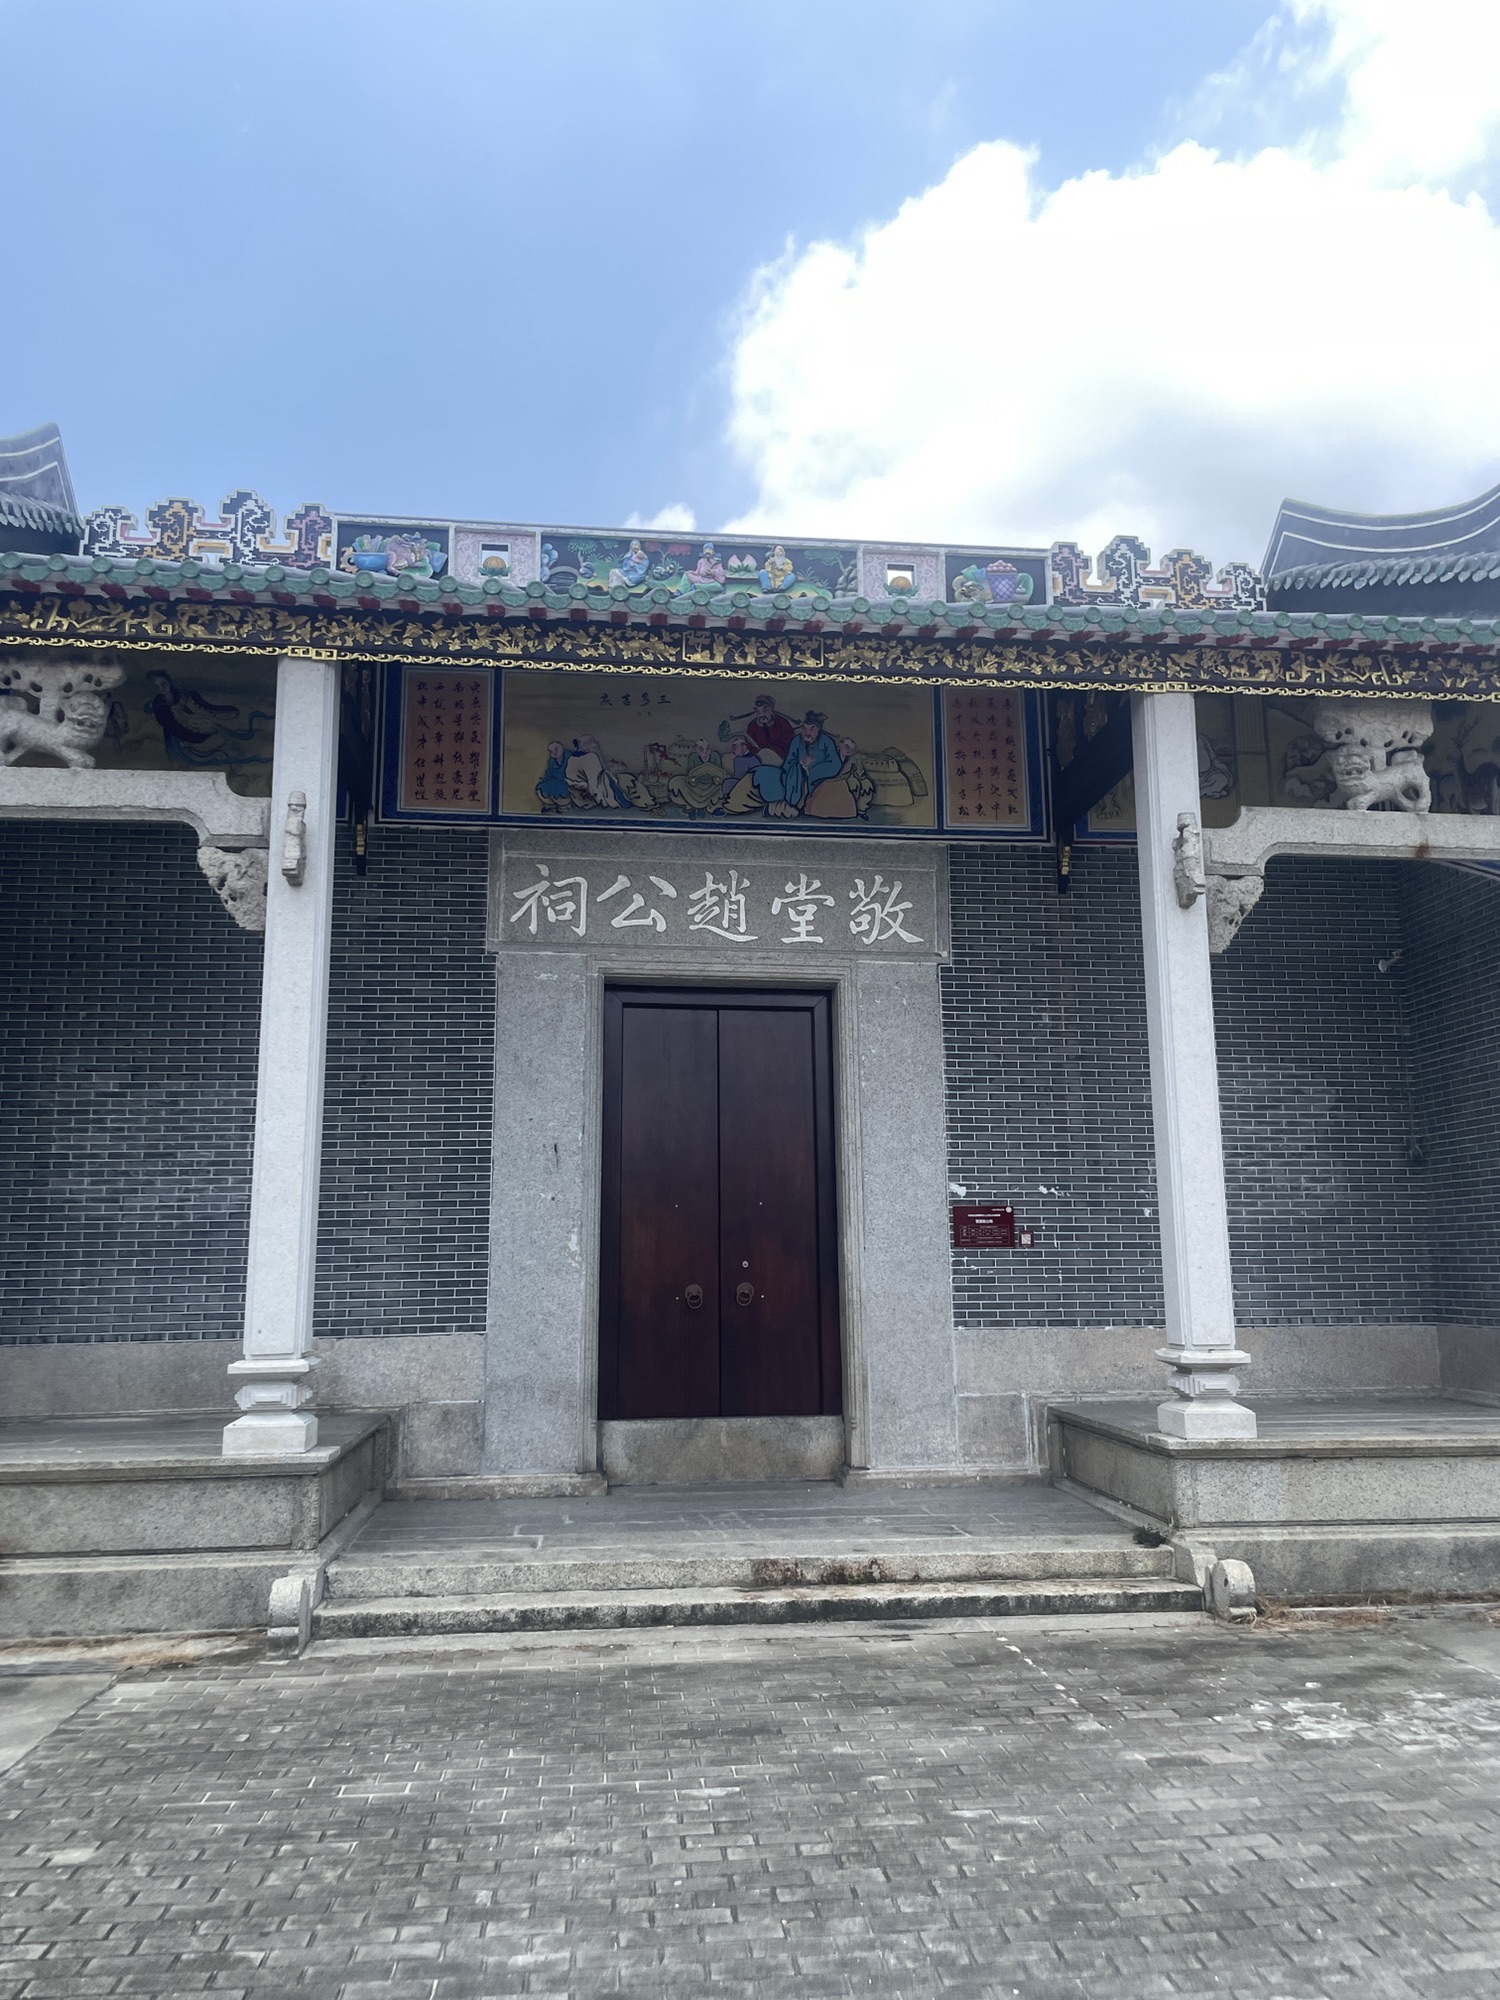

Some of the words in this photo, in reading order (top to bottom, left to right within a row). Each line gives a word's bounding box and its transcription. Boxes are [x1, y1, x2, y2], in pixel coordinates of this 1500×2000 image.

[510, 864, 924, 946] 敬堂趙公祠
